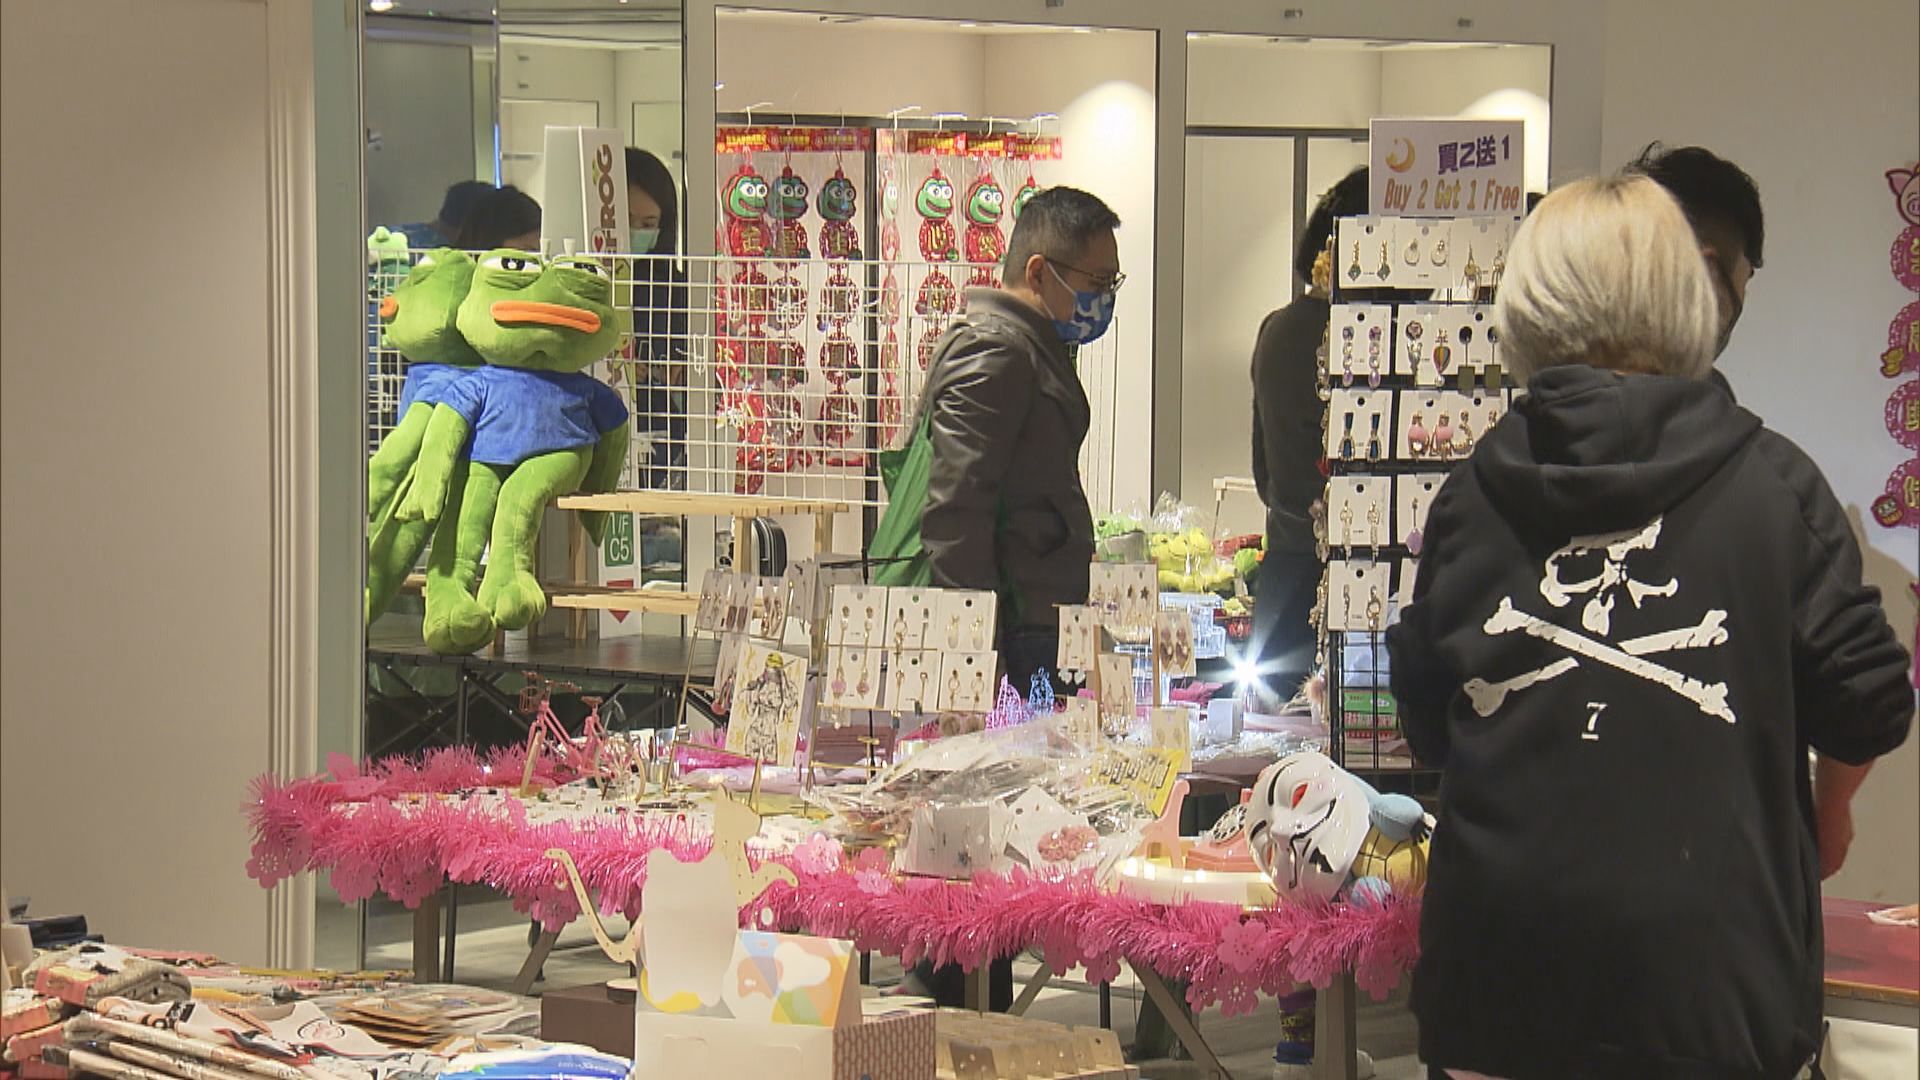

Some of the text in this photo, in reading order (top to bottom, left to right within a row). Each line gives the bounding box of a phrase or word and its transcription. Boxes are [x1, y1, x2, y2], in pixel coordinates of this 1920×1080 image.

[1383, 178, 1412, 212] Buy
[1417, 177, 1429, 209] 2
[1466, 178, 1477, 210] 1
[1483, 177, 1521, 211] Free
[609, 537, 629, 562] C5
[1584, 701, 1608, 735] 7
